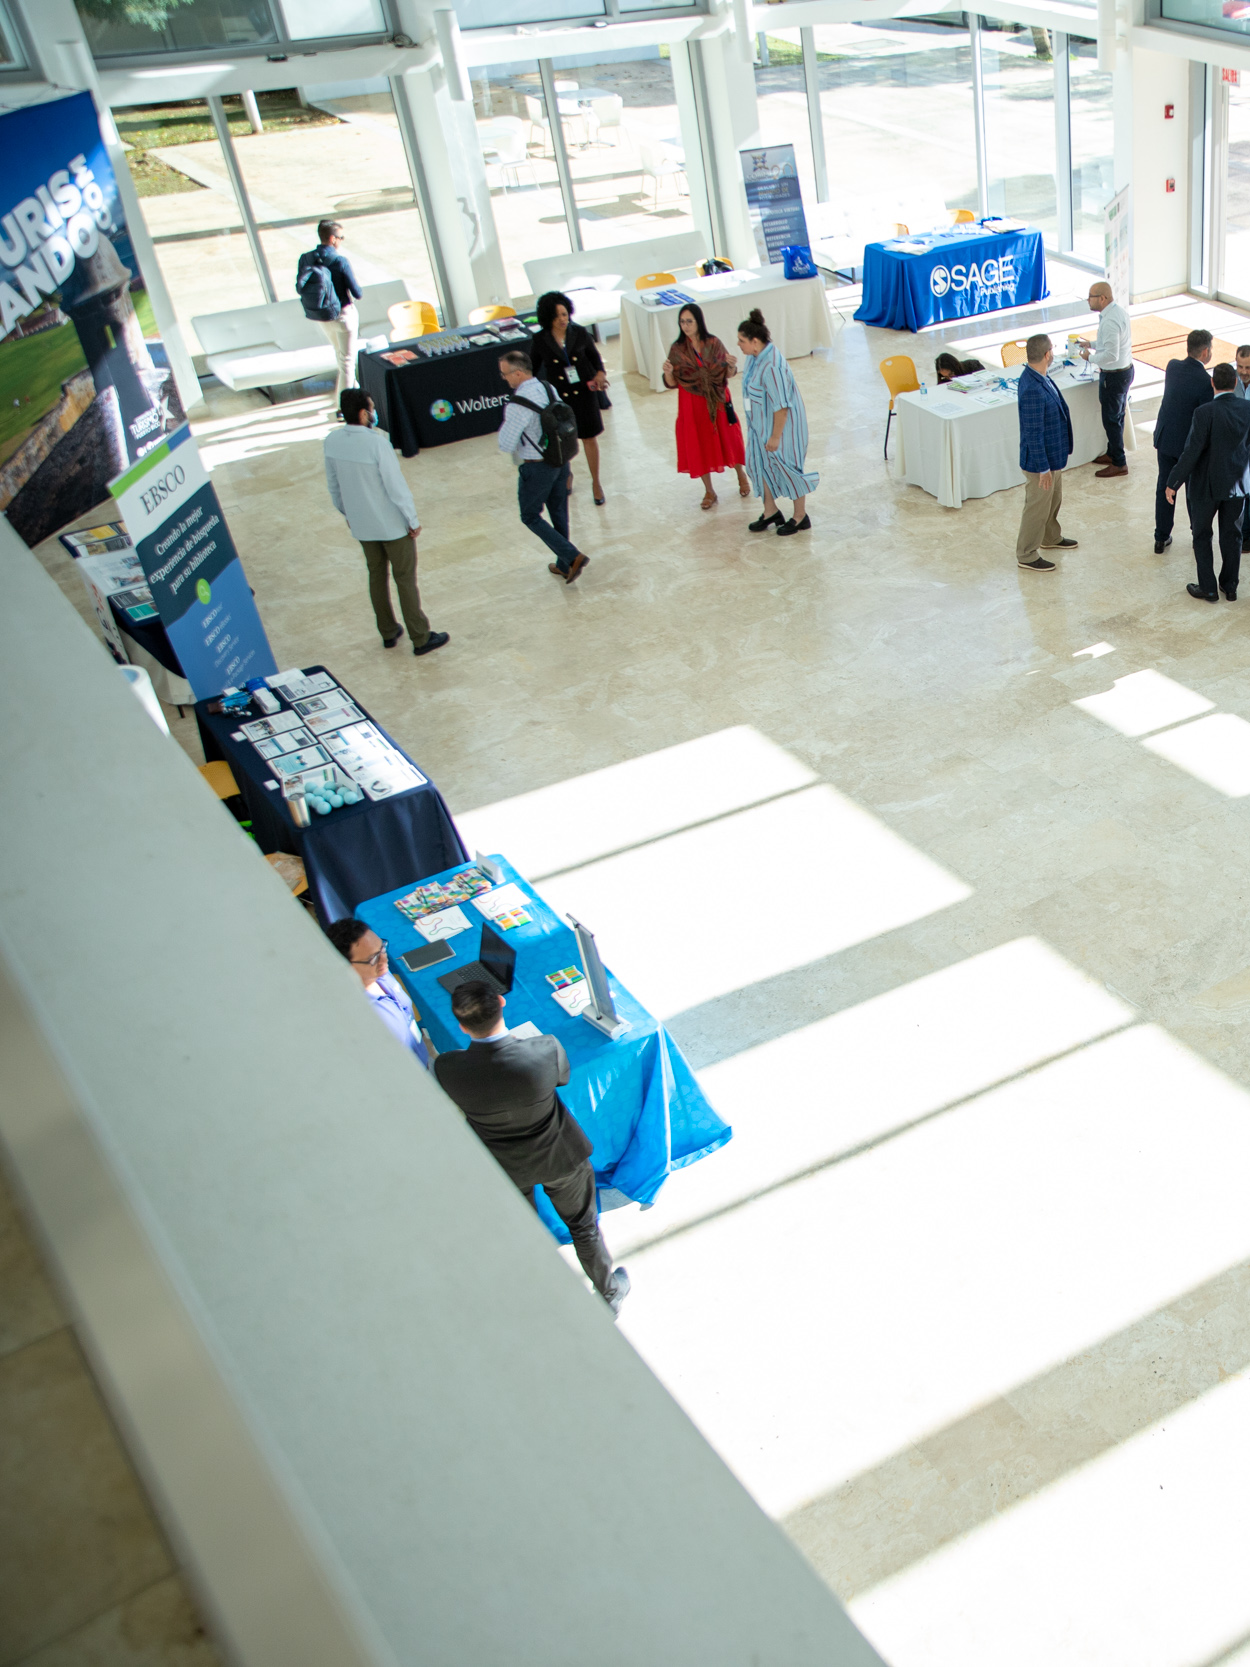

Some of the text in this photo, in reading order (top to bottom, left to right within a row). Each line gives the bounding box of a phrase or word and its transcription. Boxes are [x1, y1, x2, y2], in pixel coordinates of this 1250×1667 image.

[0, 213, 100, 342] ANDO
[951, 255, 1014, 292] SAGE
[980, 283, 1015, 296] Publishing
[456, 394, 510, 414] Wolters
[140, 465, 185, 516] EBSCO
[155, 506, 204, 556] Creando la mejor
[149, 547, 187, 584] experiencia
[184, 538, 194, 552] de
[170, 541, 217, 596] para su biblioteca
